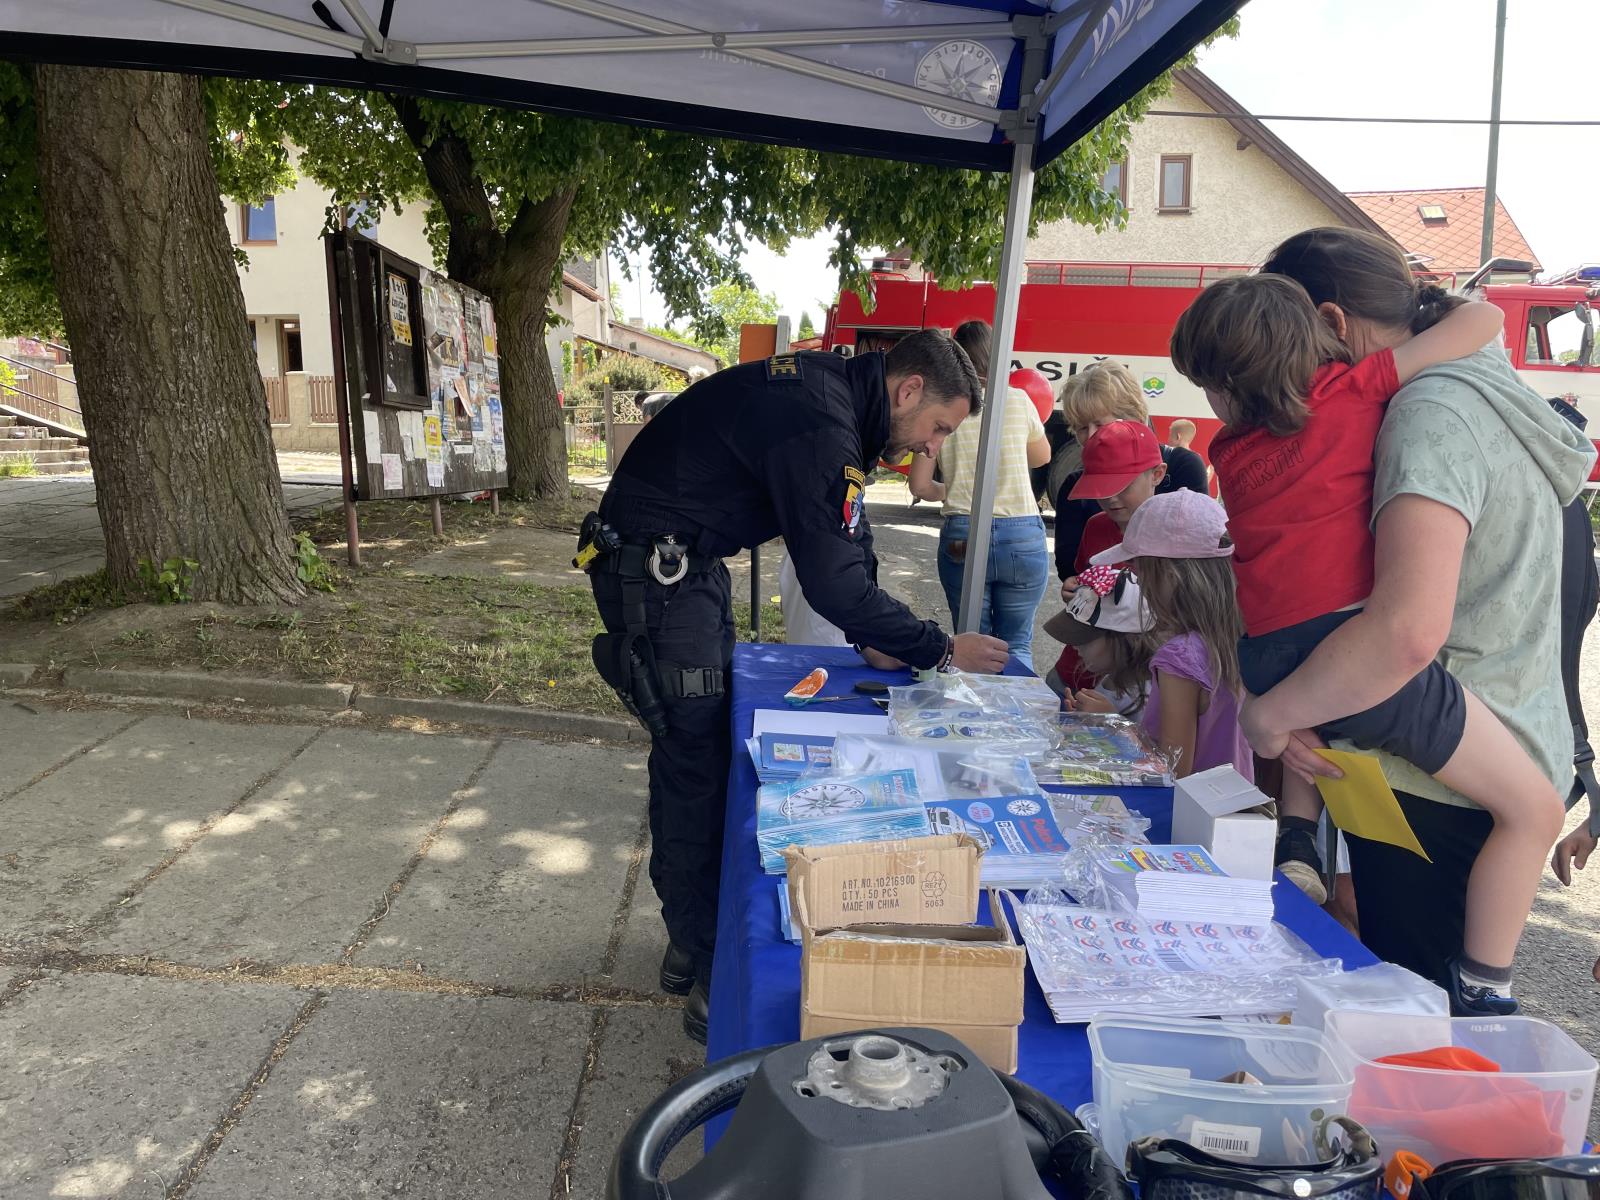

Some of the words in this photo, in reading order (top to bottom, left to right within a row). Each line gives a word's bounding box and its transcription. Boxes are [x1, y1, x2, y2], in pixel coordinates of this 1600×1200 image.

[842, 891, 867, 901] QTY.:
[868, 889, 879, 899] 50
[882, 887, 898, 898] PCS
[842, 901, 864, 912] MADE
[866, 900, 874, 911] IN
[877, 899, 900, 910] CHINA
